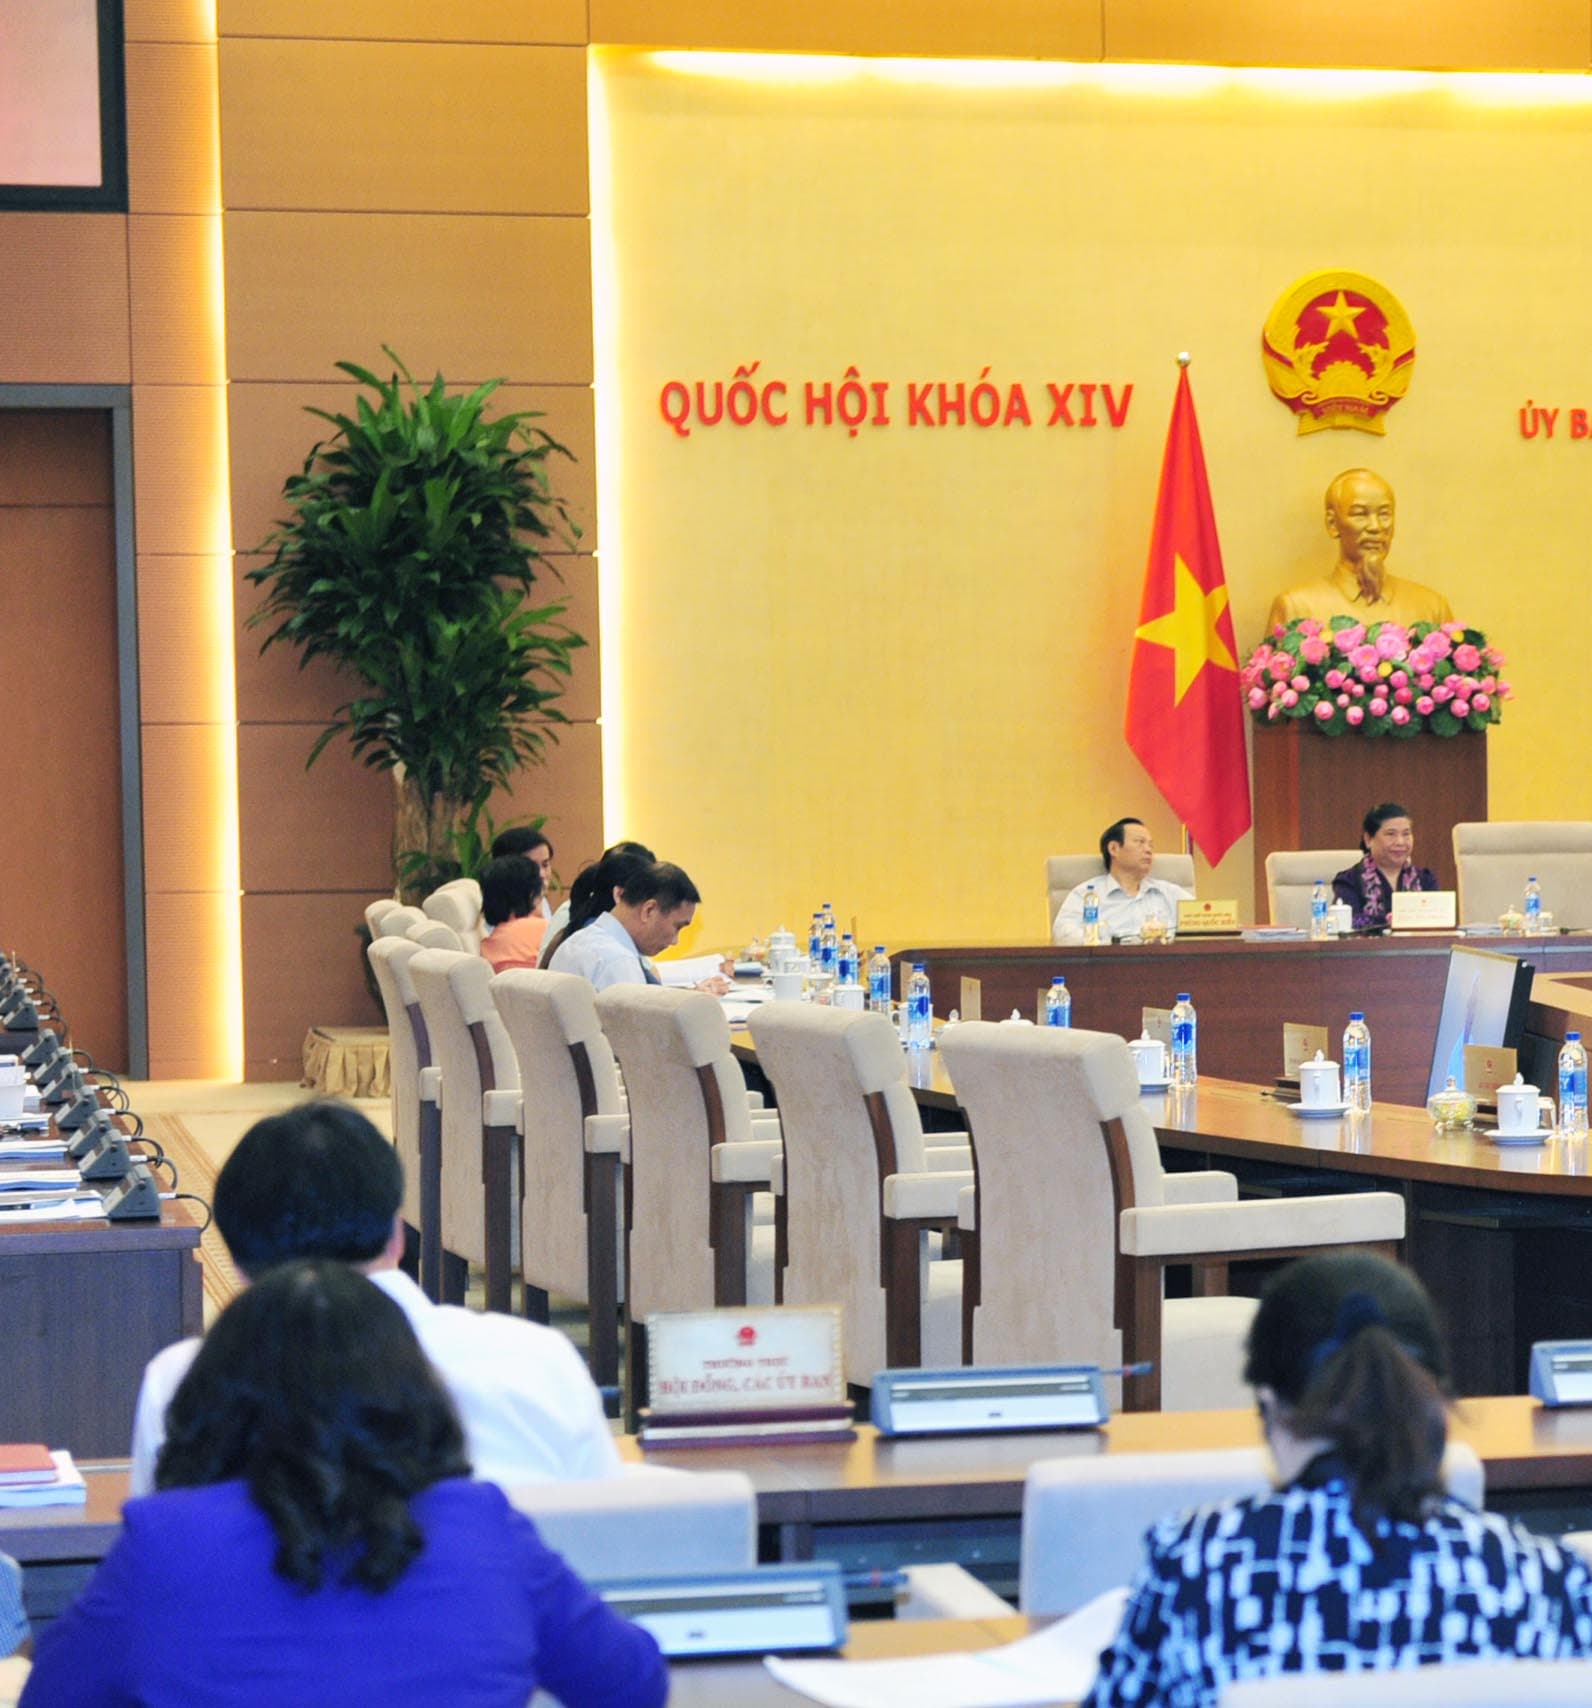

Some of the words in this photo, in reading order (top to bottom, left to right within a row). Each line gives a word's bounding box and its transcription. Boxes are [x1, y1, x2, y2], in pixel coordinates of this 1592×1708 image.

[660, 362, 789, 439] QUỐC
[805, 367, 891, 439] HỘI
[908, 367, 1033, 429] KHÓA
[1047, 383, 1135, 429] XIV
[1519, 400, 1560, 440] ỦY
